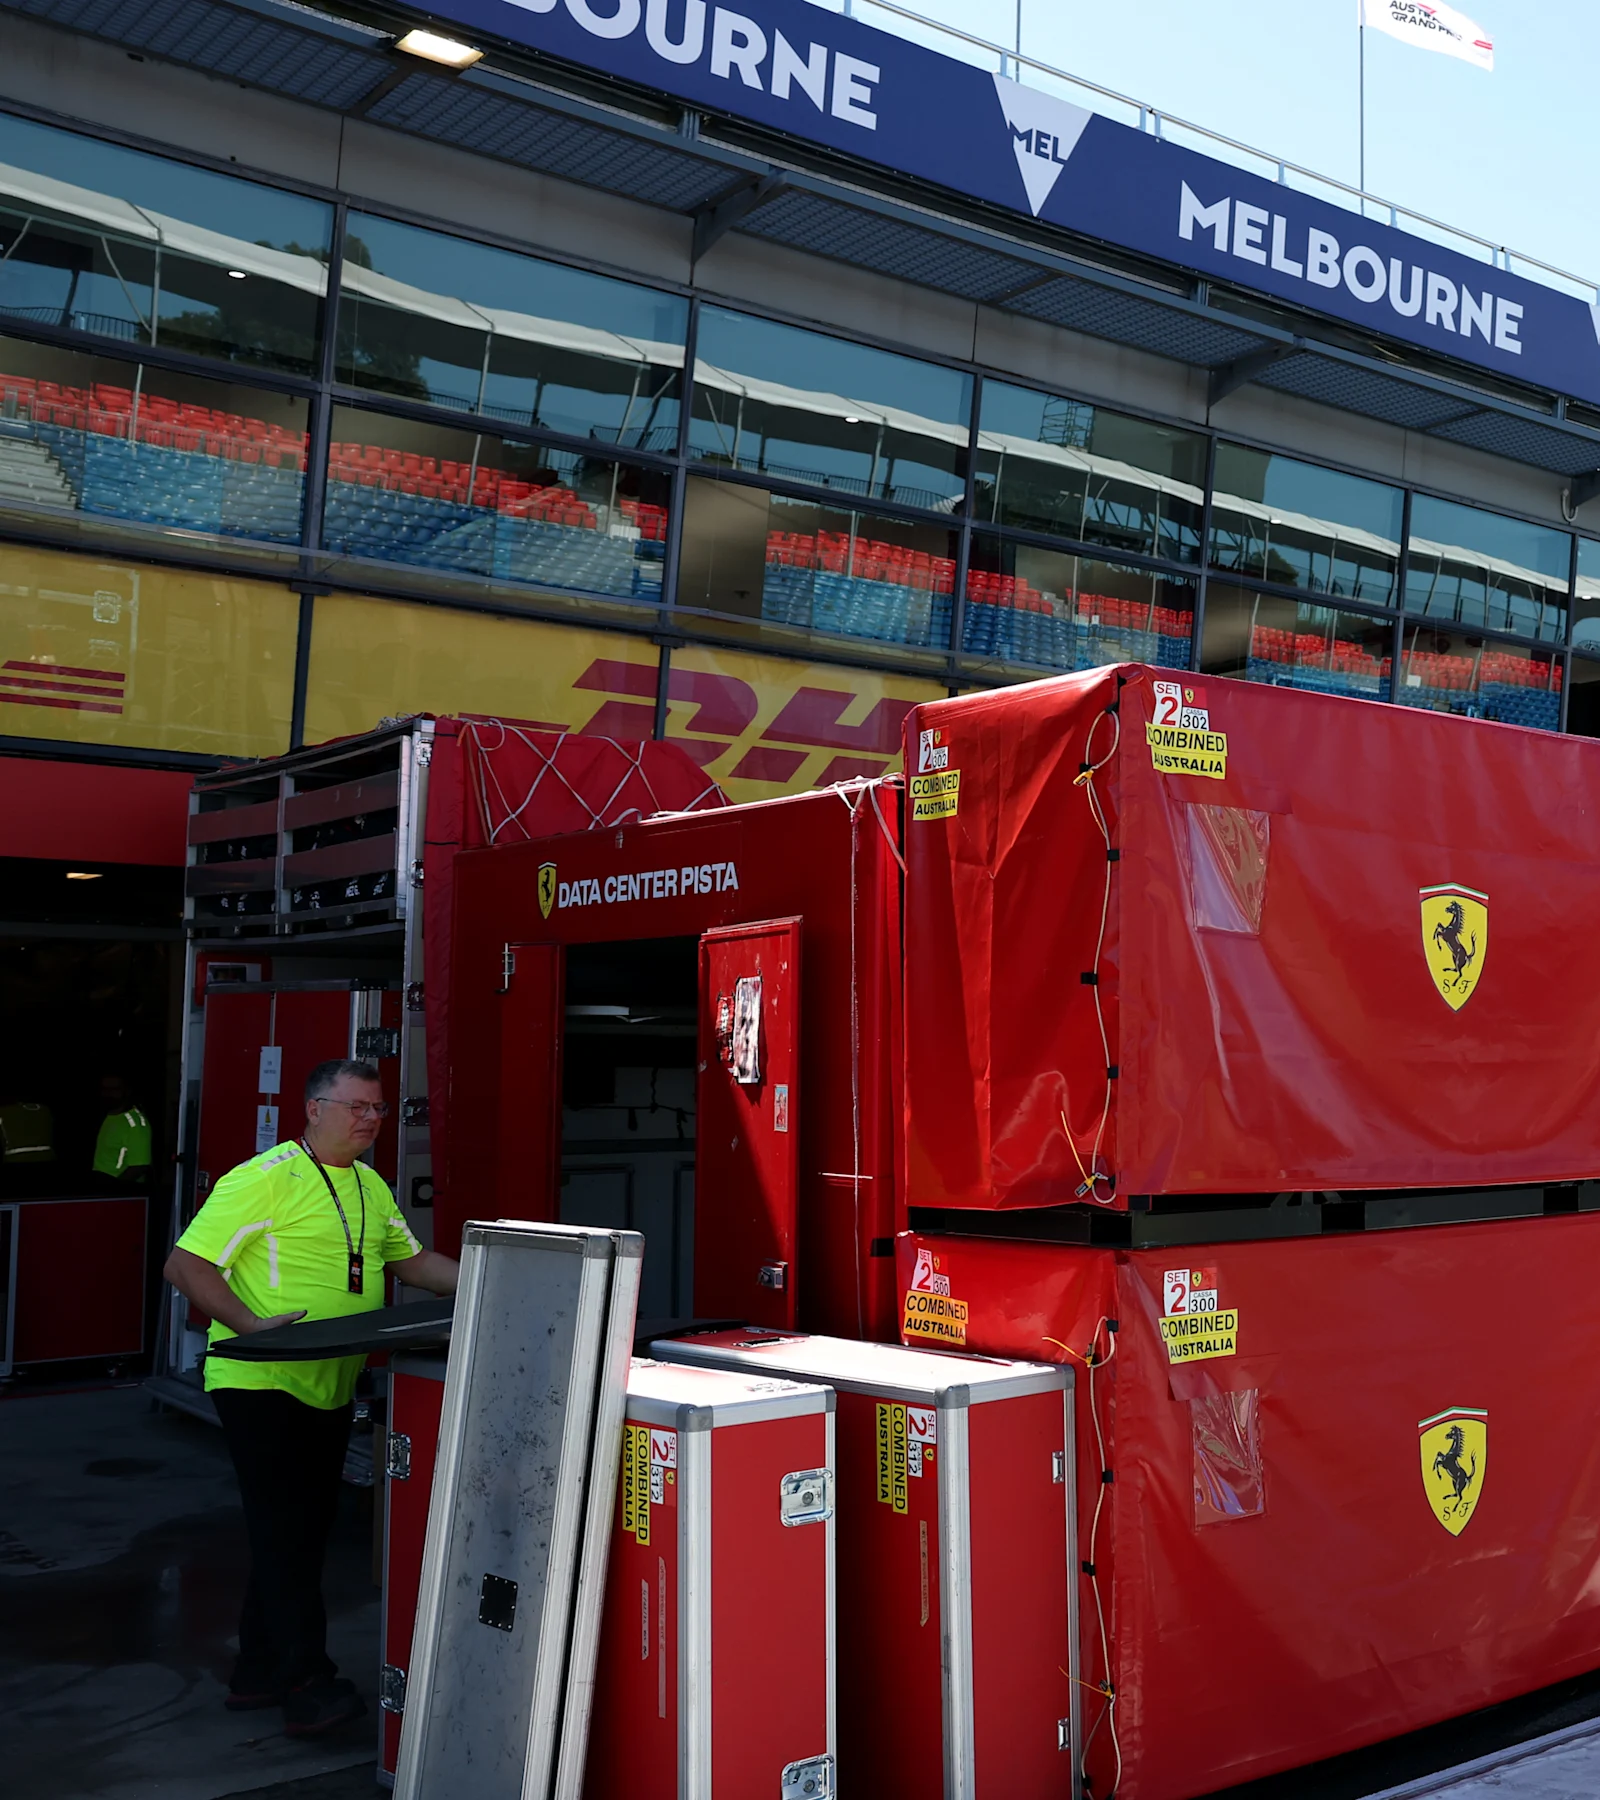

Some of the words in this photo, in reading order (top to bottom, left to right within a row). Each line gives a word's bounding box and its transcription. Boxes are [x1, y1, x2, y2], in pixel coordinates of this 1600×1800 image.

[1392, 11, 1436, 30] GRAND
[1006, 119, 1068, 166] MEL
[1178, 180, 1524, 355] MELBOURNE
[1156, 683, 1178, 695] SET
[1160, 696, 1178, 726] 2
[1182, 715, 1207, 730] 302
[922, 730, 932, 743] SET
[1148, 727, 1224, 752] COMBINED
[924, 743, 931, 770] 2
[932, 754, 946, 768] 302
[1154, 752, 1223, 773] AUSTRALIA
[912, 774, 957, 795] COMBINED
[915, 799, 956, 815] AUSTRALIA
[558, 878, 602, 908] DATA
[604, 869, 677, 903] CENTER
[681, 862, 739, 895] PISTA
[1442, 979, 1451, 993] S
[920, 1251, 930, 1261] SET
[917, 1262, 931, 1290] 2
[1167, 1271, 1187, 1283] SET
[934, 1281, 949, 1296] 300
[1171, 1283, 1187, 1313] 2
[907, 1295, 966, 1321] COMBINED
[1191, 1297, 1215, 1312] 300
[905, 1317, 964, 1340] AUSTRALIA
[1161, 1314, 1234, 1339] COMBINED
[1170, 1338, 1233, 1358] AUSTRALIA
[908, 1414, 927, 1437] 2
[652, 1438, 669, 1462] 2
[668, 1436, 676, 1464] SET
[879, 1406, 889, 1500] AUSTRALIA
[893, 1407, 905, 1510] COMBINED
[908, 1441, 917, 1474] 312
[625, 1428, 633, 1528] AUSTRALIA
[638, 1430, 648, 1540] COMBINED
[651, 1467, 659, 1501] 312
[1442, 1506, 1451, 1521] S
[1459, 1501, 1474, 1518] F
